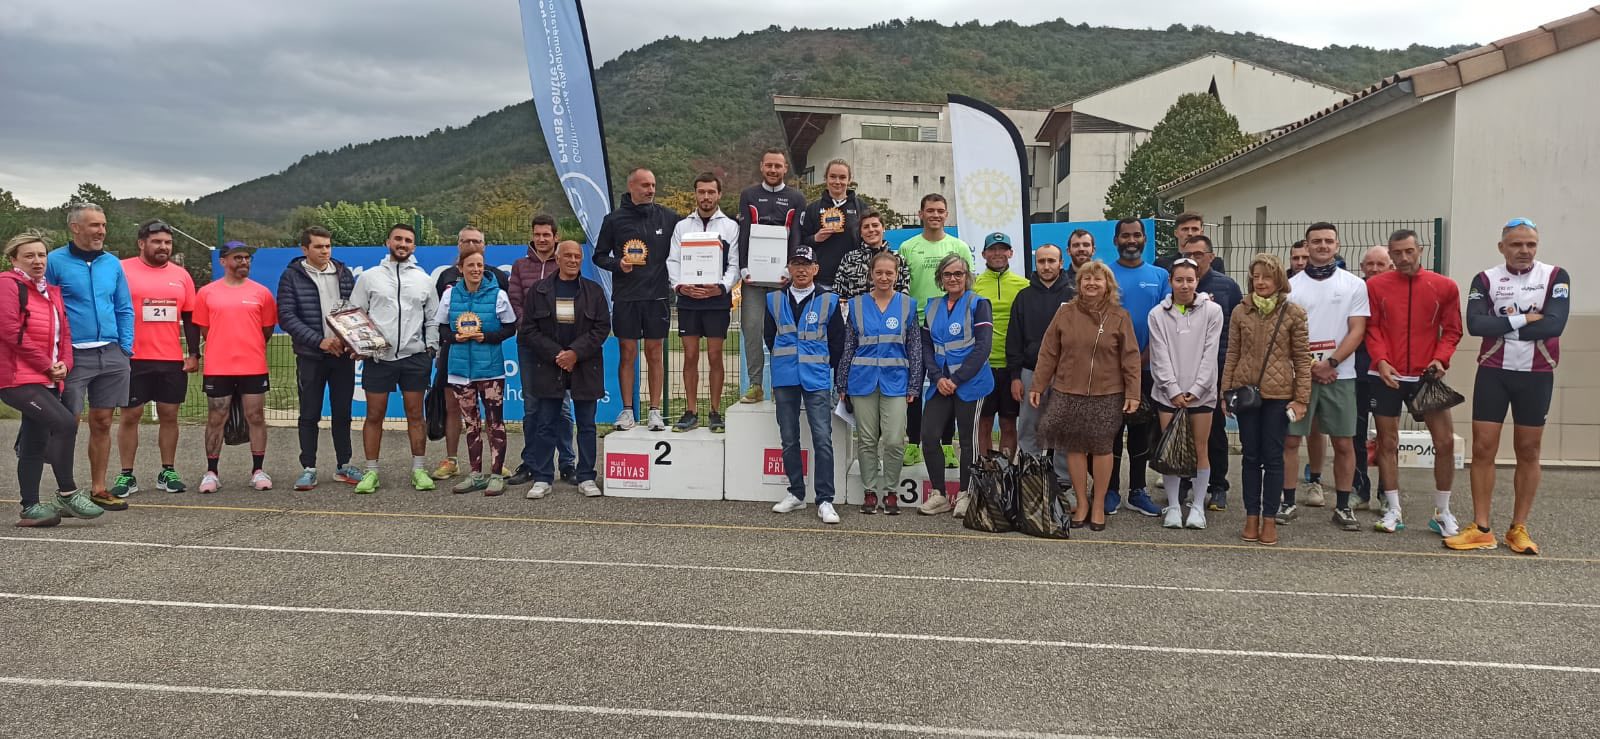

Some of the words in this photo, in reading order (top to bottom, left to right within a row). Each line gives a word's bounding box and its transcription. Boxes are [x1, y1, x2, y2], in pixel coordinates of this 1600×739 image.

[153, 307, 167, 317] 21
[654, 440, 672, 465] 2
[610, 465, 645, 478] PRIVAS
[768, 461, 785, 473] PRI
[899, 478, 919, 504] 3
